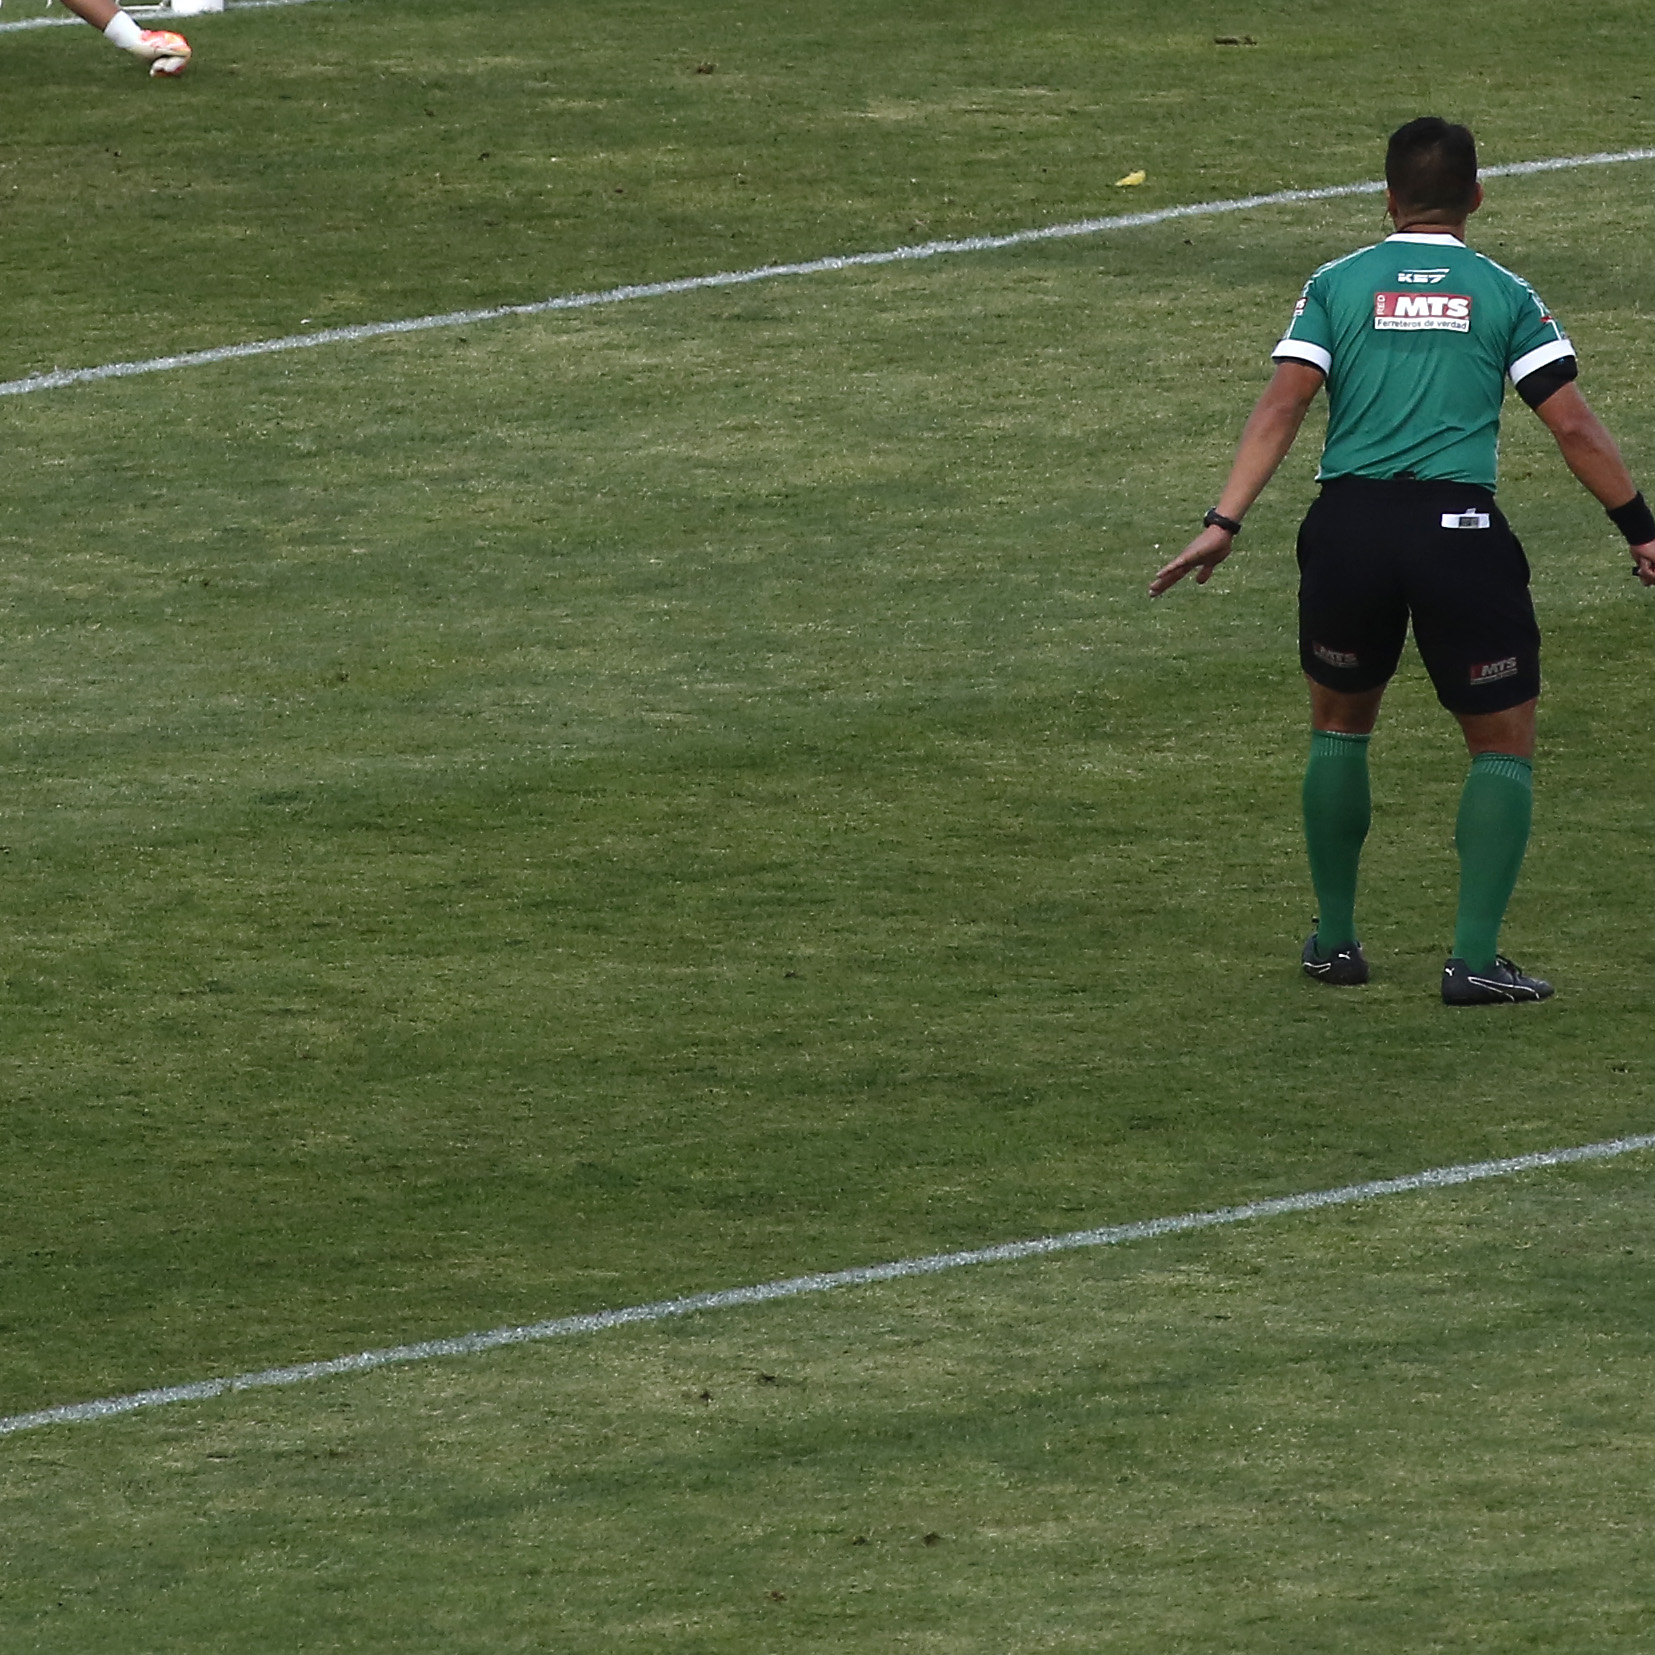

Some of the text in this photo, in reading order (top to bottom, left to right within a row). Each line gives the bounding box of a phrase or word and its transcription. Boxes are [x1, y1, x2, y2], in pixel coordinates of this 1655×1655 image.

[1394, 295, 1470, 317] MTS
[1376, 319, 1467, 330] Ferreteros de verdad
[1481, 656, 1517, 677] MTS
